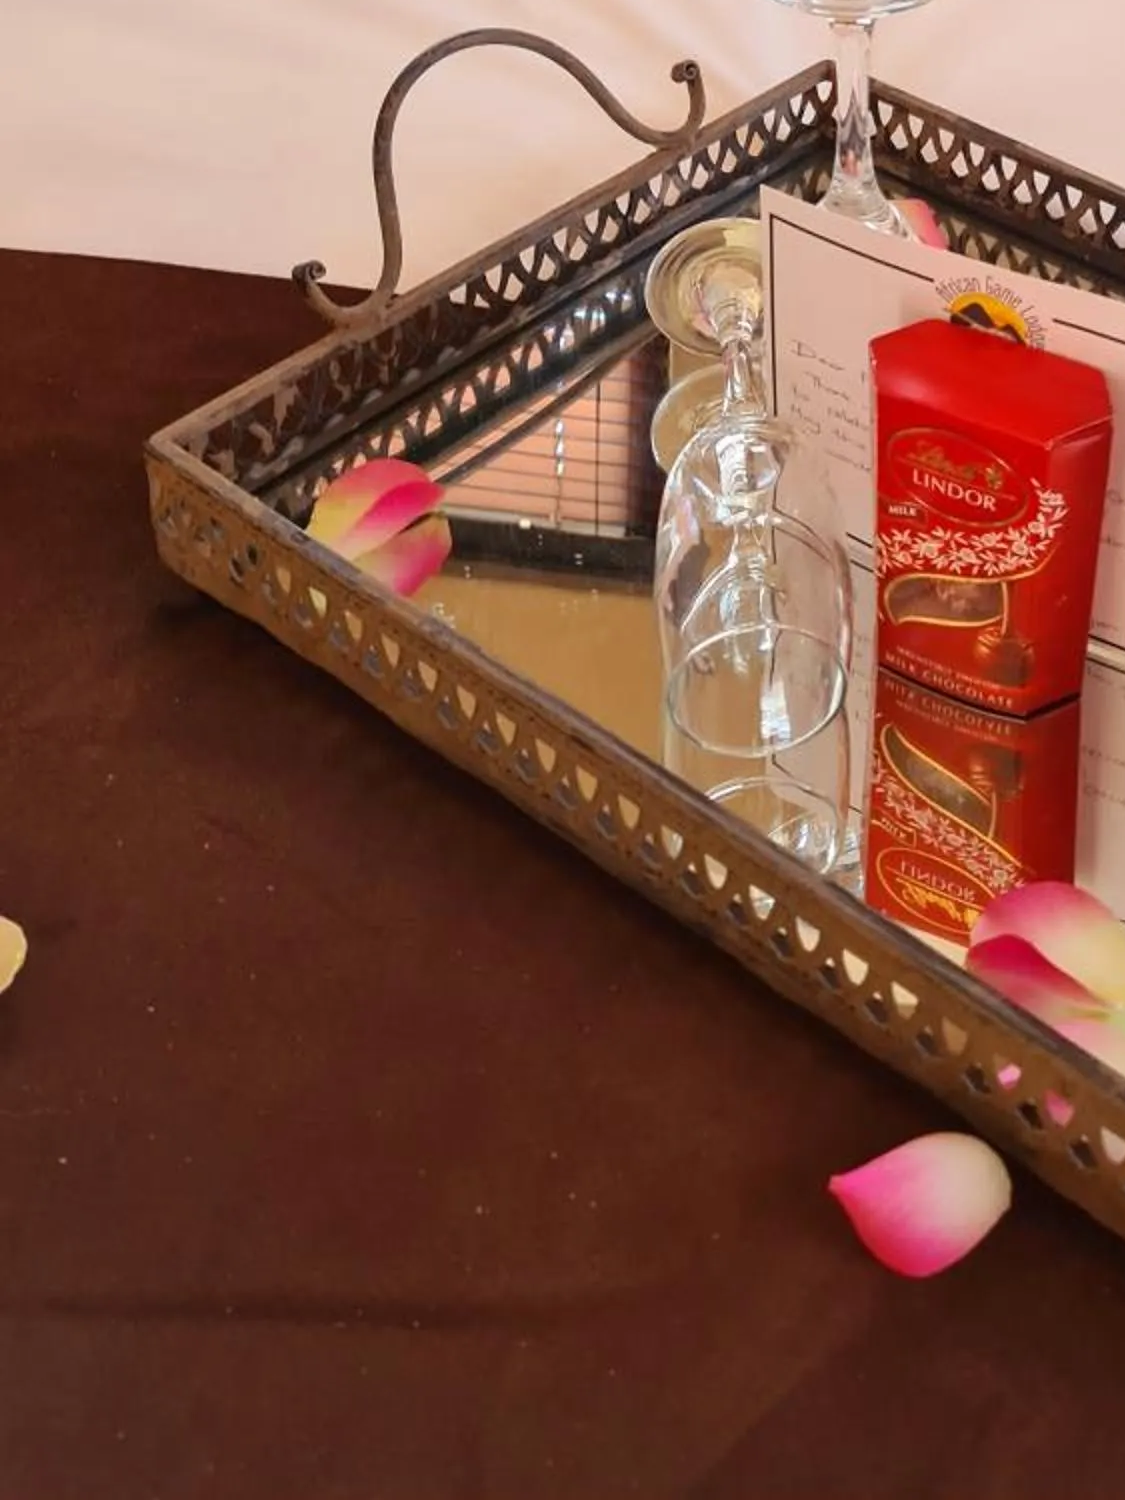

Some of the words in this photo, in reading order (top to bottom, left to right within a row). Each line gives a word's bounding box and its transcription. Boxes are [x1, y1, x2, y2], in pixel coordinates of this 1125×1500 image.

[985, 275, 1023, 309] Game
[912, 468, 996, 512] LINDOR
[922, 670, 1013, 708] CHOCOLATE
